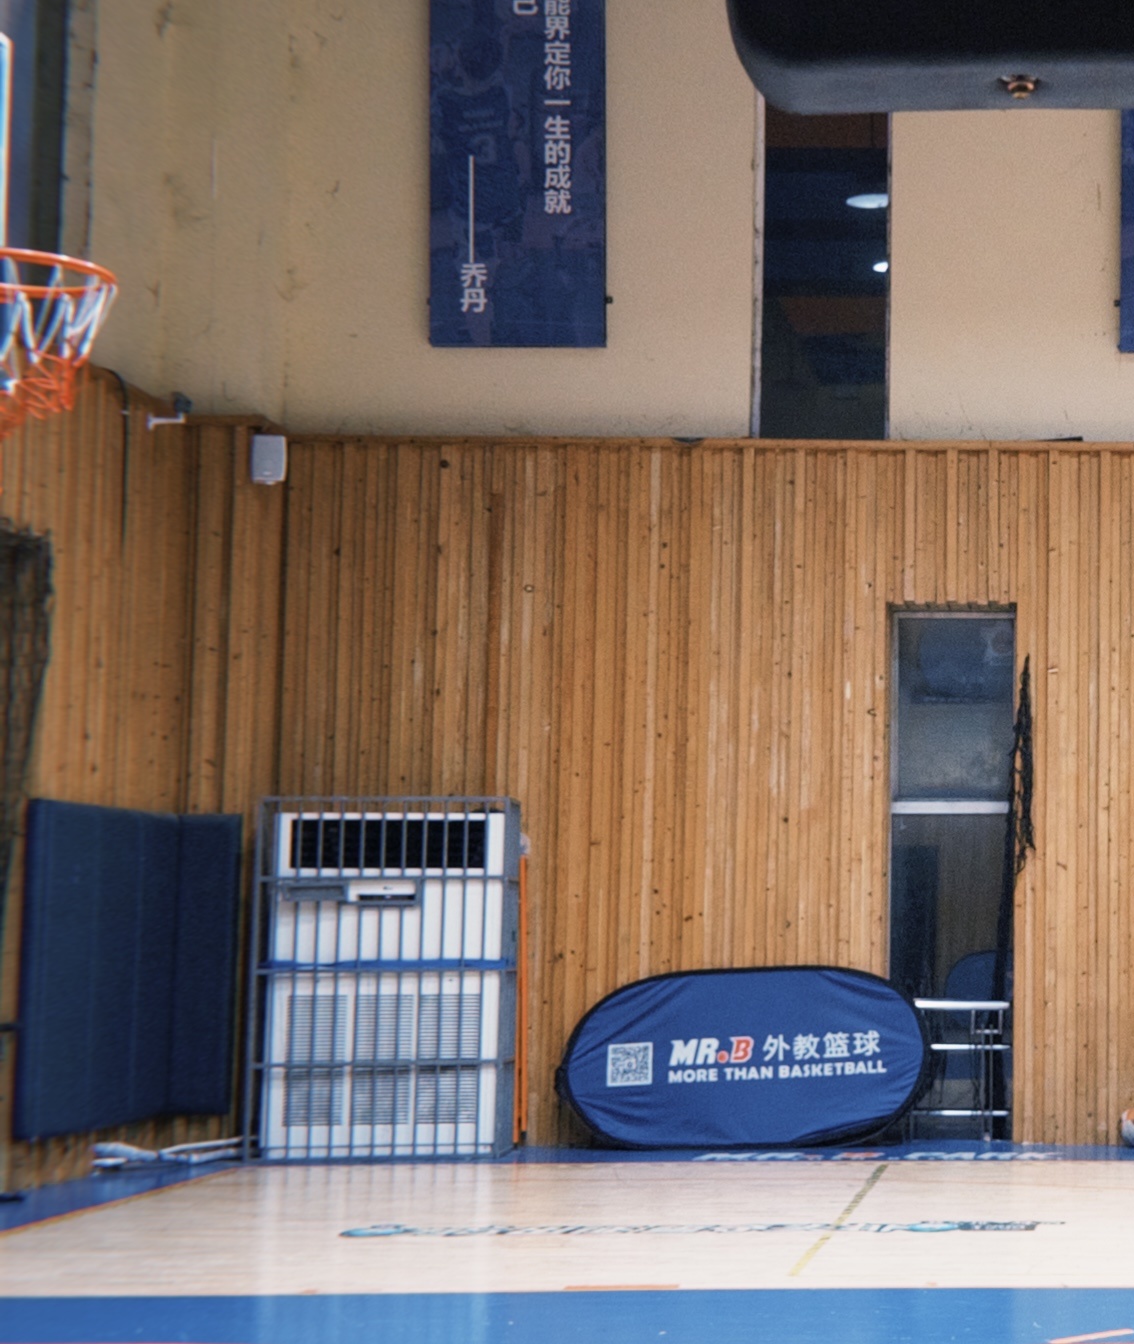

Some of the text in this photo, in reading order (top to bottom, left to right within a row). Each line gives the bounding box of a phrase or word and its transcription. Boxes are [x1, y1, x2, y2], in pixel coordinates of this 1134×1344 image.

[669, 1030, 881, 1067] MR.B 外教篮球
[668, 1060, 887, 1084] MORE THAN BASKETBALL
